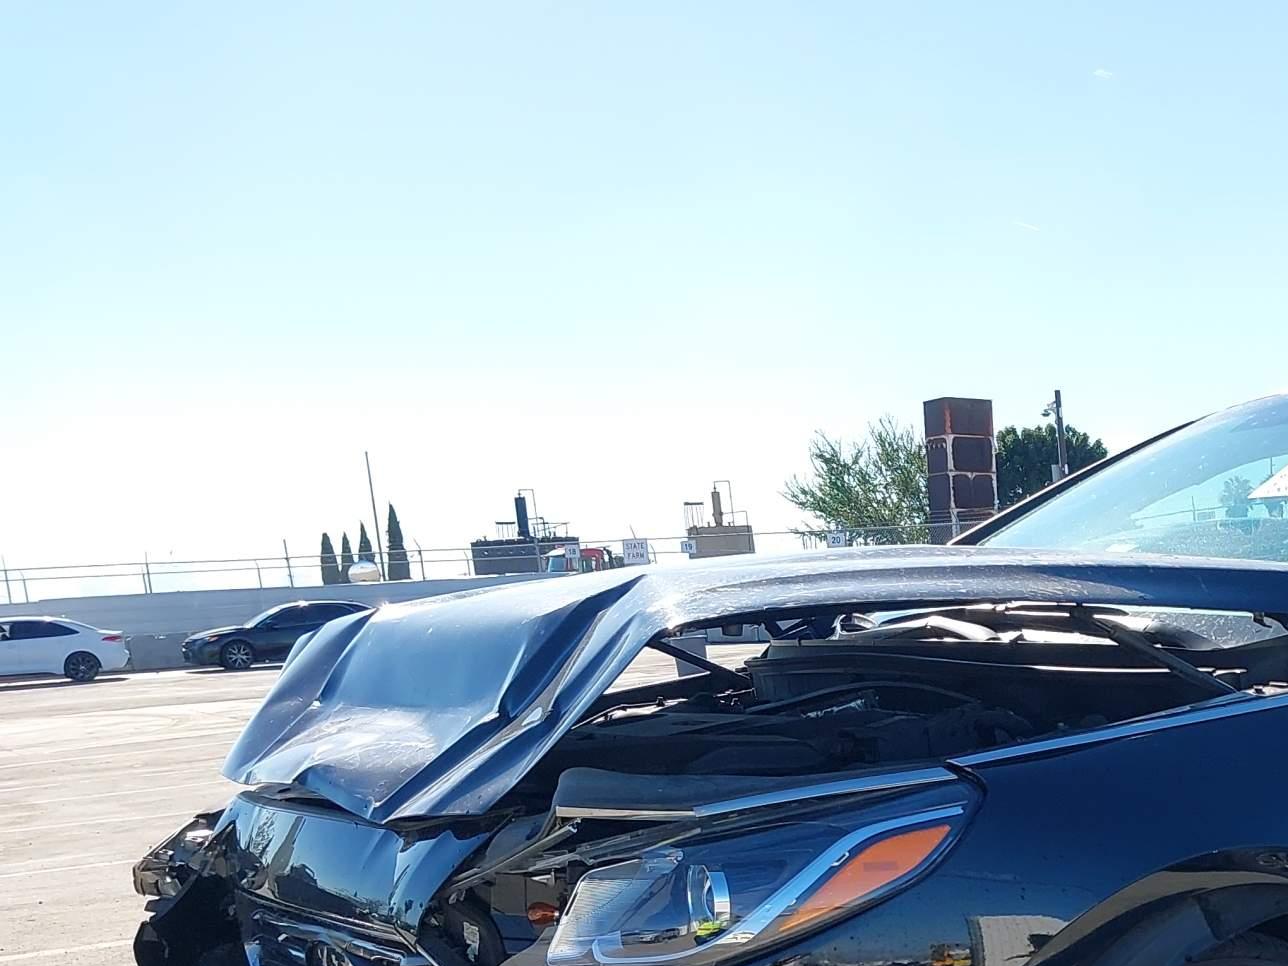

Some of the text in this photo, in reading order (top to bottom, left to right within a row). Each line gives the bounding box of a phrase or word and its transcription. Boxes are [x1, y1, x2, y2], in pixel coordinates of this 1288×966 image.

[831, 536, 841, 544] 20
[625, 542, 645, 550] STATE
[684, 543, 693, 551] 19
[627, 552, 645, 560] FARM
